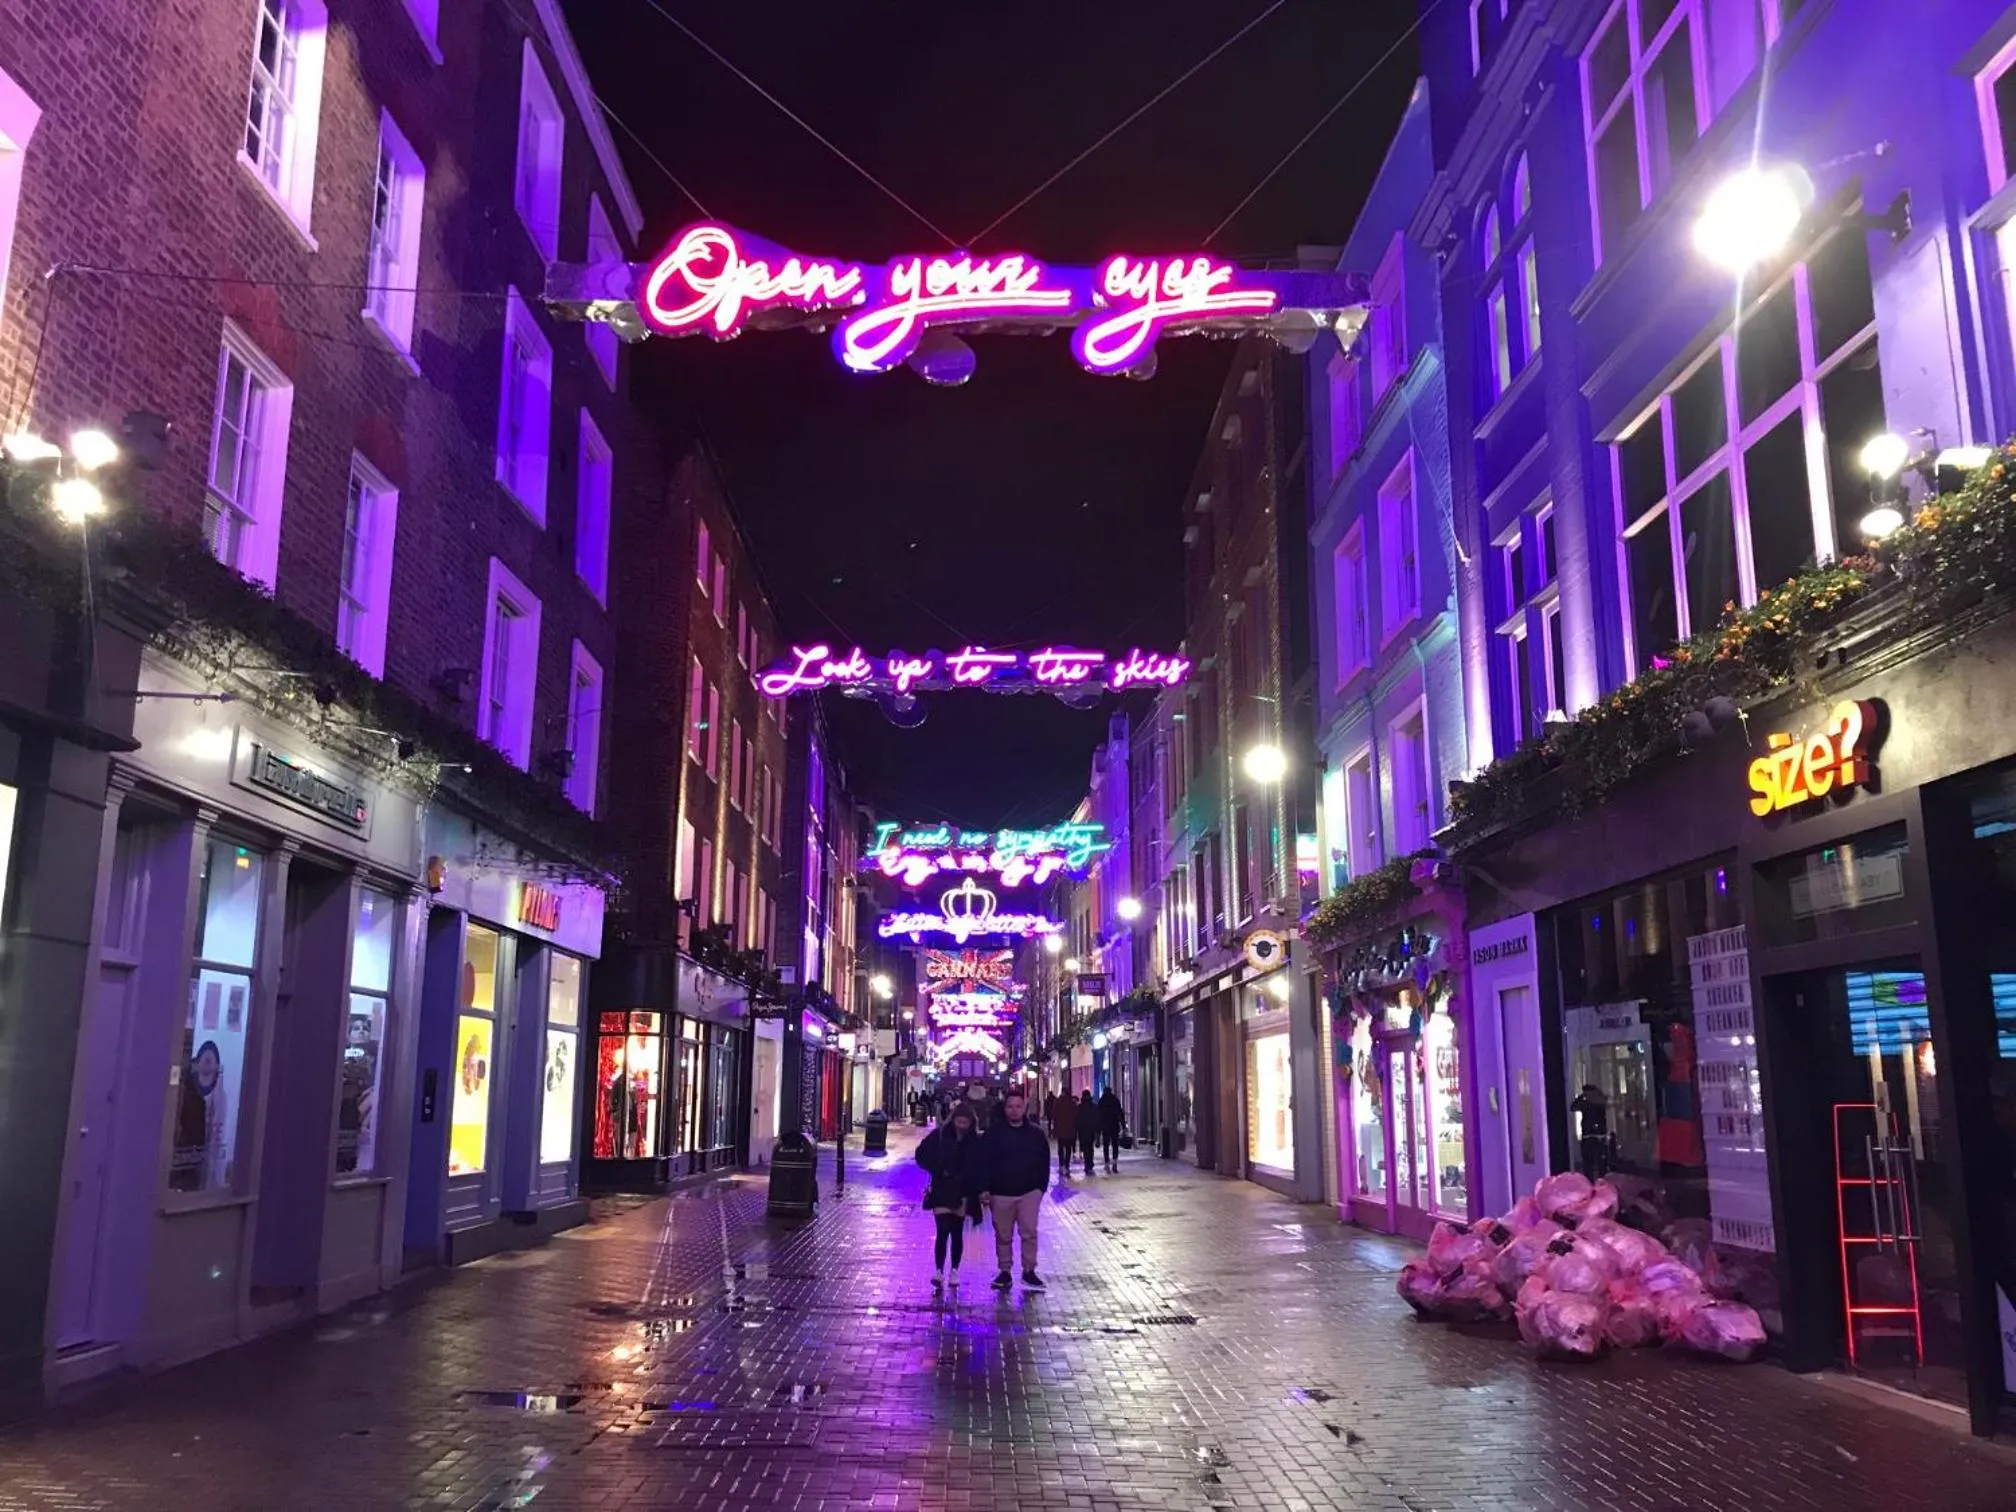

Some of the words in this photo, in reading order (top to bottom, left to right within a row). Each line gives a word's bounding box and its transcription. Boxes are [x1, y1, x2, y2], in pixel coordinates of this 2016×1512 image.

[647, 224, 862, 332] Open
[843, 255, 1071, 371] your
[1081, 255, 1276, 367] eyes
[762, 645, 871, 694] Look
[889, 658, 932, 693] up
[946, 646, 1017, 682] to
[1030, 646, 1105, 682] the
[1114, 649, 1191, 688] skies
[1749, 700, 1865, 817] size?
[867, 823, 898, 856] I
[902, 827, 950, 845] need
[959, 833, 988, 845] no
[996, 823, 1111, 868] sympathy
